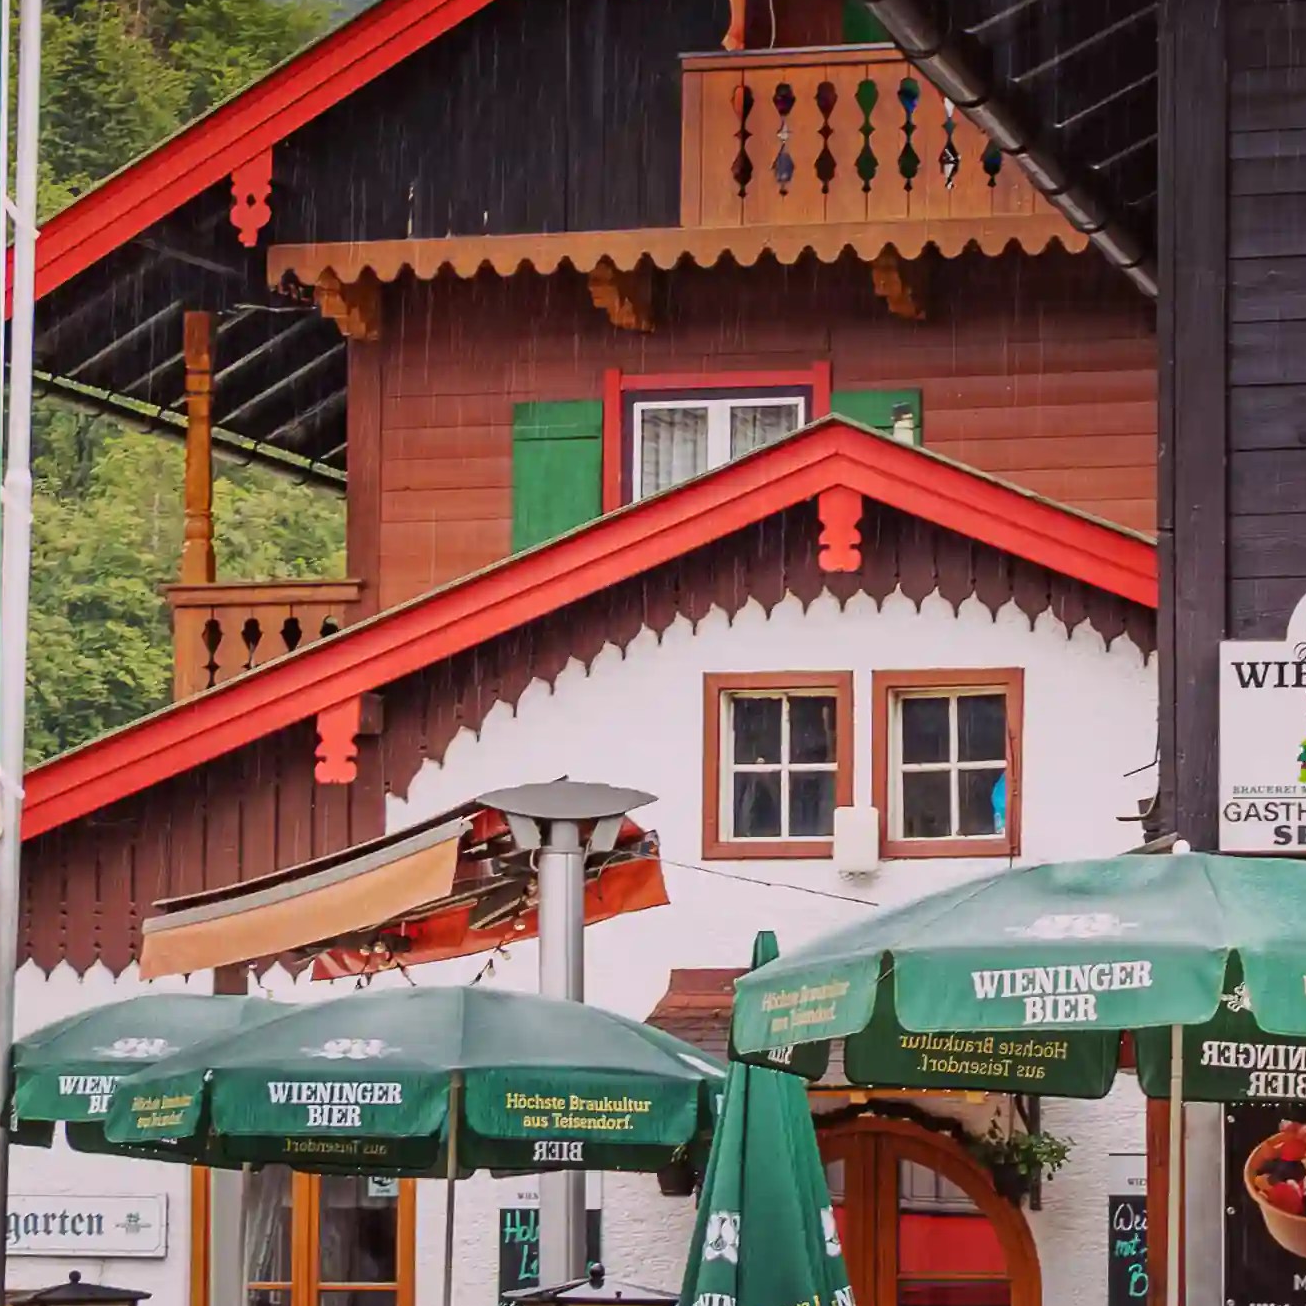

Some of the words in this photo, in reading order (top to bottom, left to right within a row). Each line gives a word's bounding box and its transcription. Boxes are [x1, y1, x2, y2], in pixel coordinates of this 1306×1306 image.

[971, 960, 1153, 999] WIENINGER
[1023, 994, 1097, 1025] BIER
[267, 1081, 403, 1105] WIENINGER
[506, 1092, 566, 1111] Höchste
[568, 1095, 652, 1114] Braukultur
[306, 1104, 362, 1127] BIER
[523, 1115, 549, 1129] aus
[551, 1114, 634, 1130] Teisendorf.
